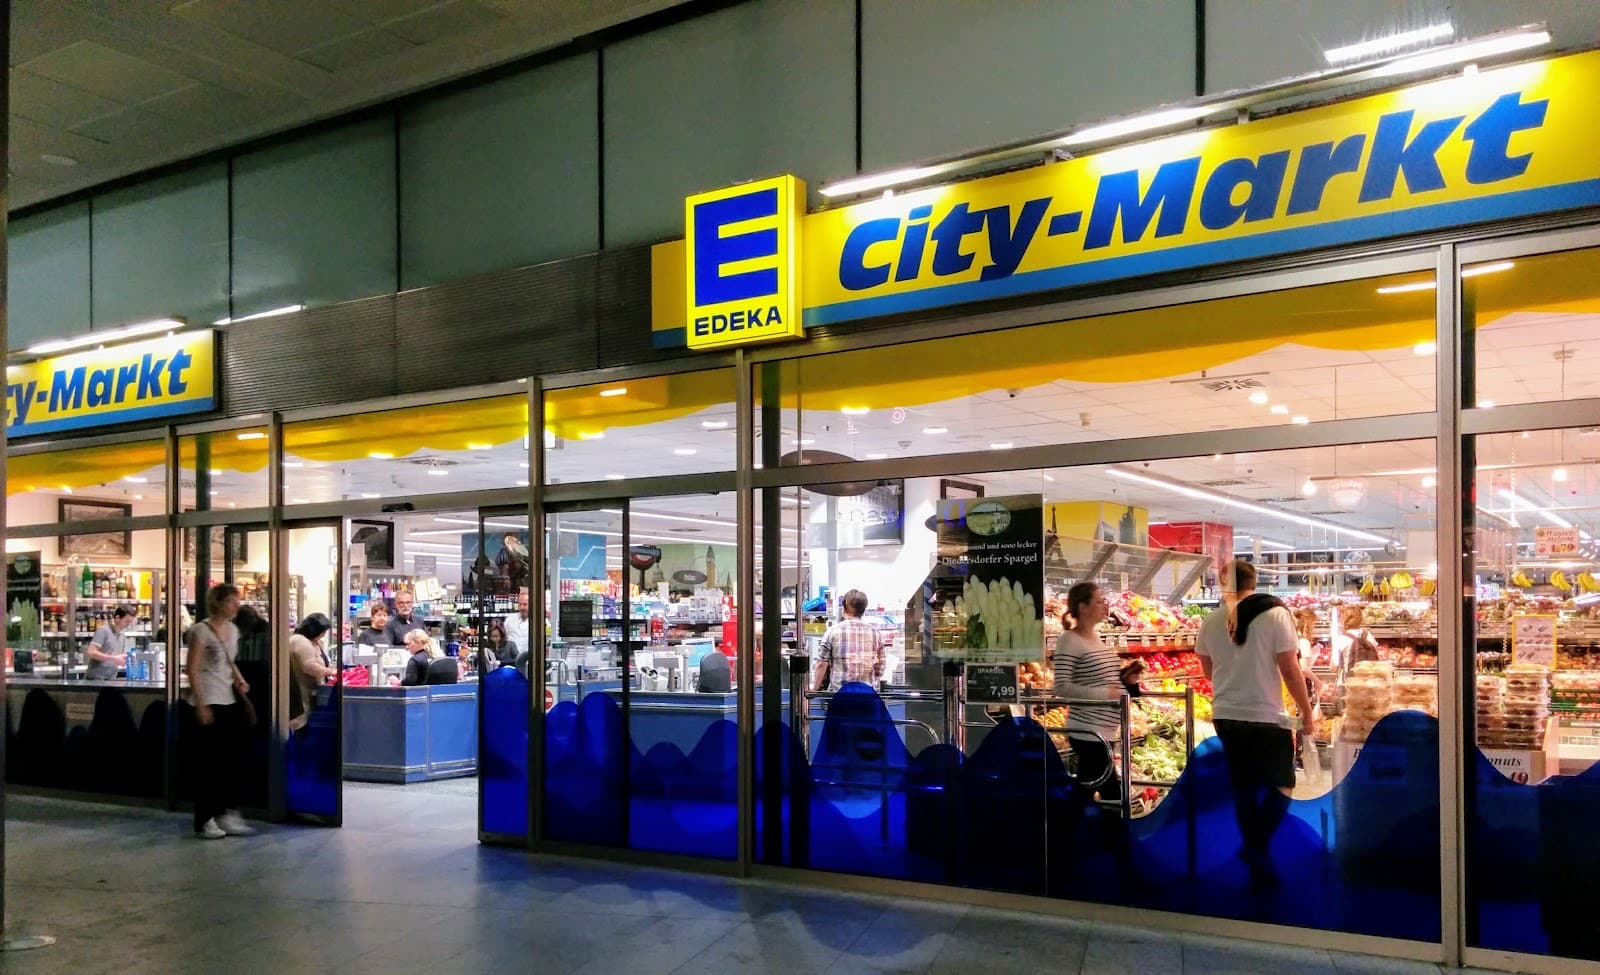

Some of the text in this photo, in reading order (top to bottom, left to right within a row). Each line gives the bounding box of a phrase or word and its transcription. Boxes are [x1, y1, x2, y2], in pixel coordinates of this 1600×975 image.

[837, 91, 1549, 291] City-Markt
[694, 188, 778, 307] E
[695, 306, 782, 336] EDEKA
[1004, 552, 1037, 565] Spargel
[990, 685, 1015, 698] 7,99
[1488, 758, 1521, 766] onuts
